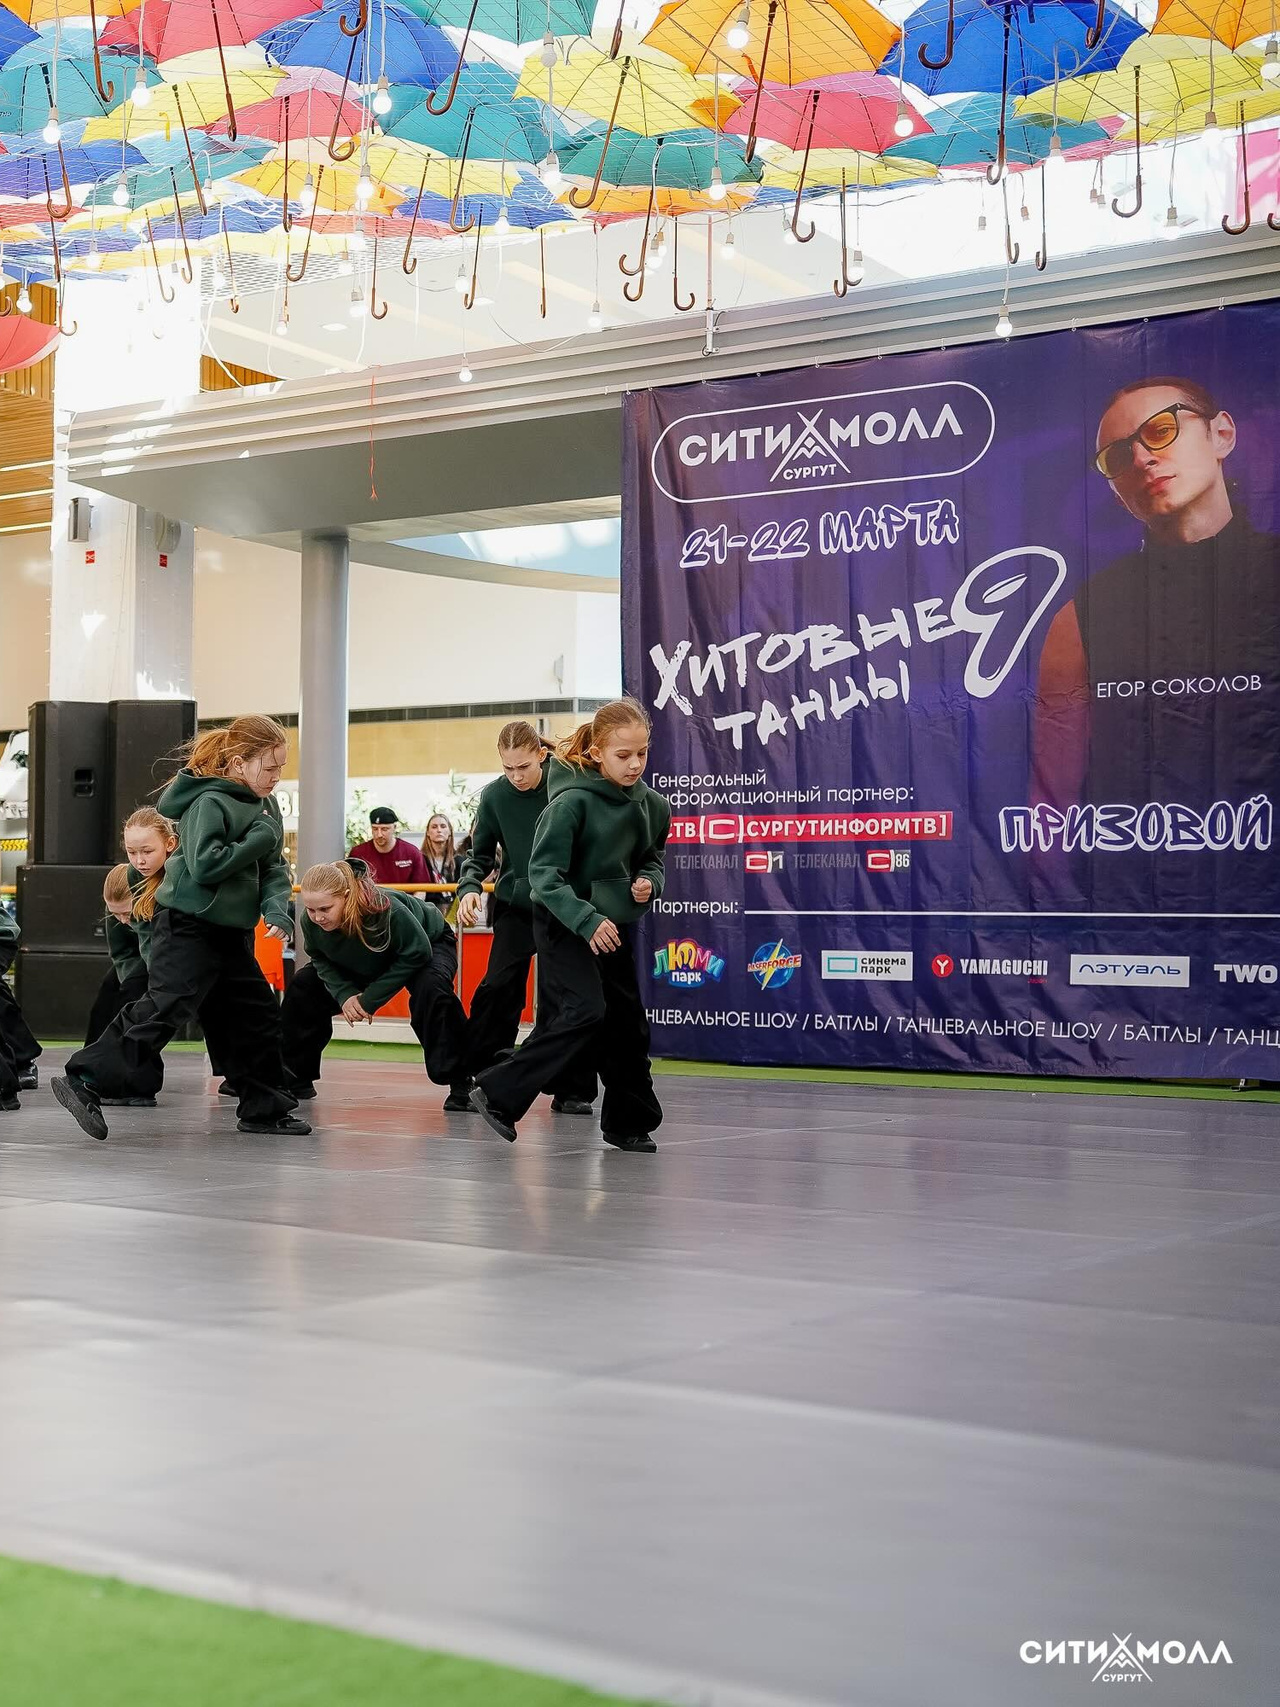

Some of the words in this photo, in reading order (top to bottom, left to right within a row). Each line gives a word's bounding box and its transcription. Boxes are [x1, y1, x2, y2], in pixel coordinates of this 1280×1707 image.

[679, 424, 791, 467] СИТИ
[830, 403, 963, 448] МОЛЛ
[783, 463, 837, 481] СУРГУТ
[679, 518, 810, 569] 21-22
[819, 499, 959, 554] МАРТА
[1097, 681, 1145, 698] ЕГОР
[1152, 675, 1262, 696] СОКОЛОВ
[713, 660, 910, 750] ТАНЦЫ
[652, 769, 766, 790] Генеральный
[661, 786, 821, 808] формационный
[827, 786, 915, 804] партнер:
[999, 794, 1273, 852] ПРИЗОВОЙ
[674, 853, 738, 870] ТЕЛЕКАНАЛ
[793, 853, 860, 870] ТЕЛЕКАНАЛ
[652, 899, 739, 917] Партнеры:
[860, 966, 891, 976] парк
[861, 956, 906, 966] синема
[960, 959, 1048, 976] YAMAGUCHI
[671, 971, 702, 985] парк
[1214, 964, 1278, 984] TWO
[645, 1008, 750, 1028] НЦЕВАЛЬНОЕ
[755, 1012, 797, 1029] ШОУ
[815, 1014, 878, 1032] БАТТЛЫ
[897, 1016, 1046, 1037] ТАНЦЕВАЛЬНОЕ
[1052, 1022, 1102, 1040] ШОУ
[1124, 1024, 1201, 1044] БАТТЛЫ
[1224, 1028, 1280, 1048] ТАНЦ
